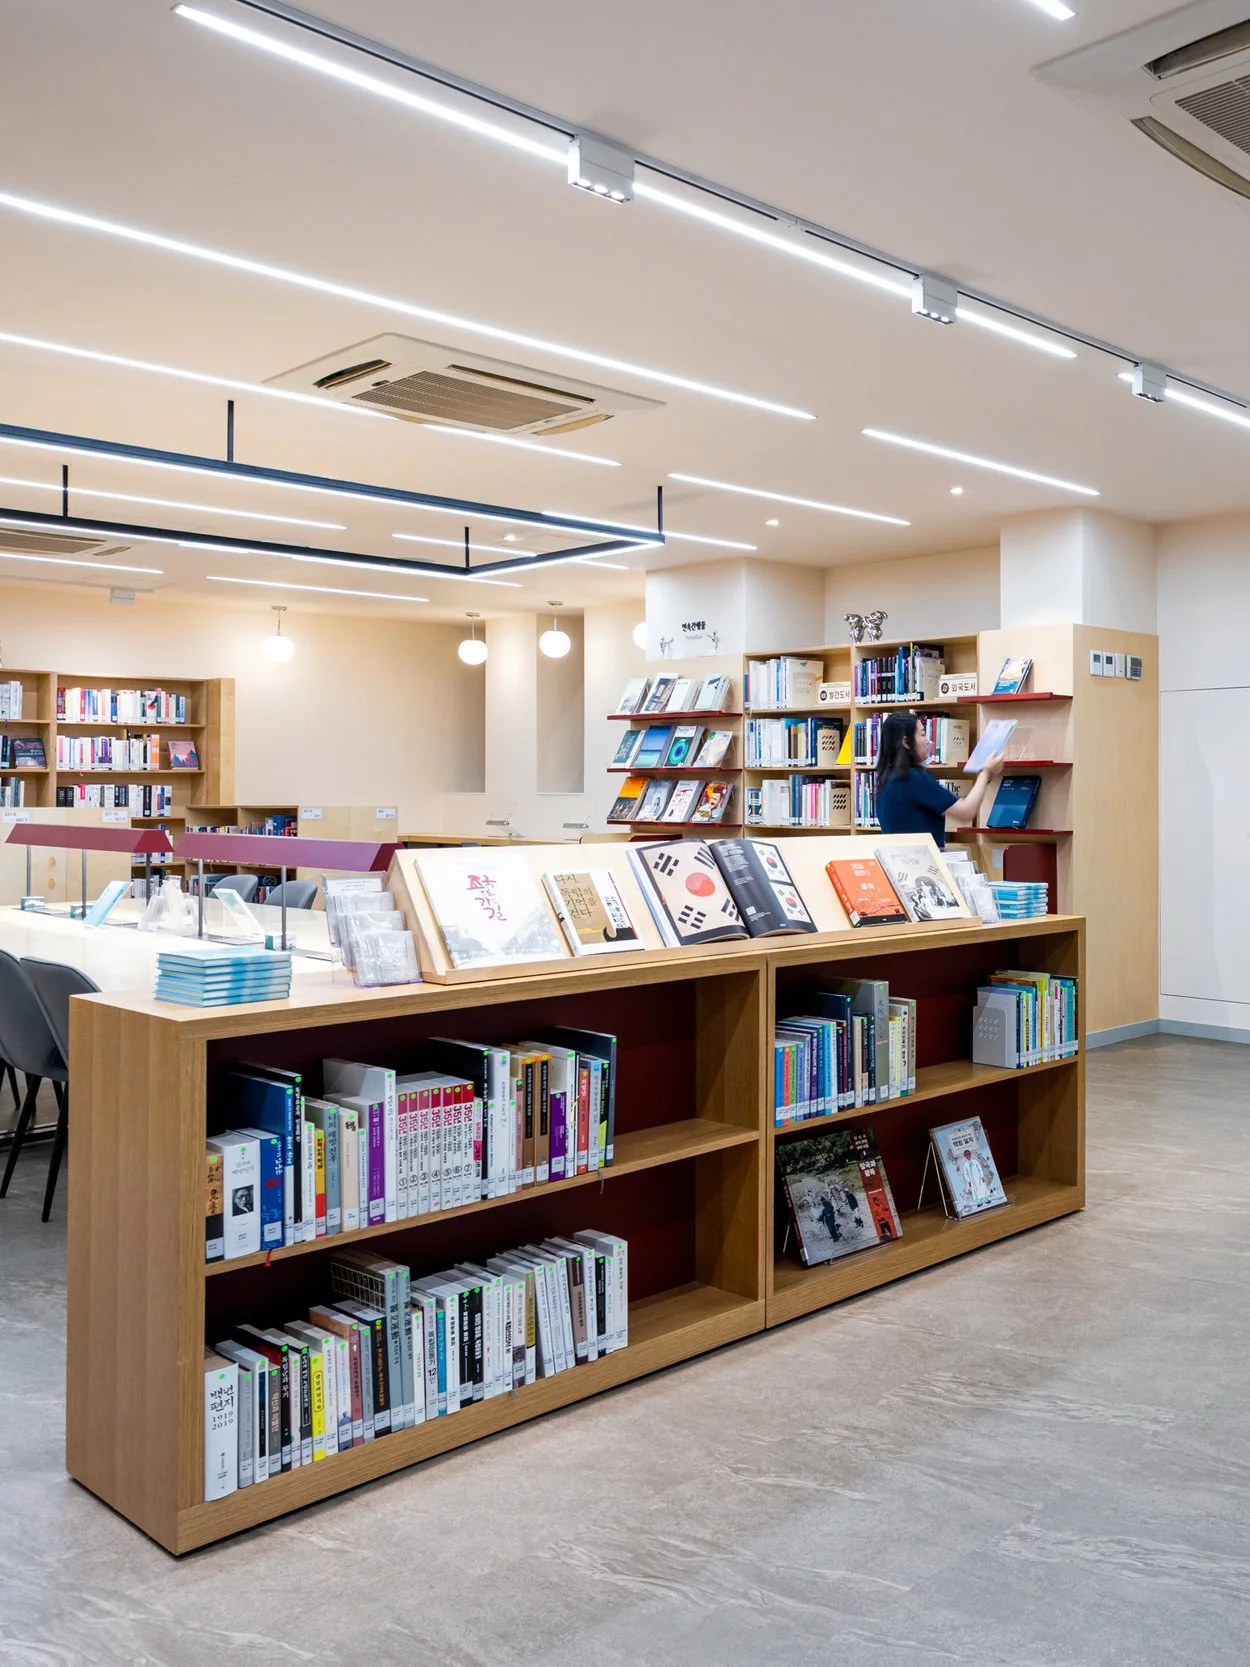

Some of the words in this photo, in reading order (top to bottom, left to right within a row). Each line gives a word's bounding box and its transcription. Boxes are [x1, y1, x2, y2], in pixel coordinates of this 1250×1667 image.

[951, 682, 976, 693] 외국도서
[420, 1111, 428, 1131] 35년
[431, 1109, 440, 1128] 35년
[443, 1107, 452, 1126] 35년
[453, 1105, 462, 1124] 35년
[463, 1104, 473, 1122] 35년
[399, 1115, 407, 1135] 35년
[409, 1113, 418, 1134] 35년
[210, 1384, 234, 1399] 백년
[210, 1396, 234, 1413] 편지
[211, 1418, 234, 1431] 2019
[212, 1411, 234, 1422] 1919
